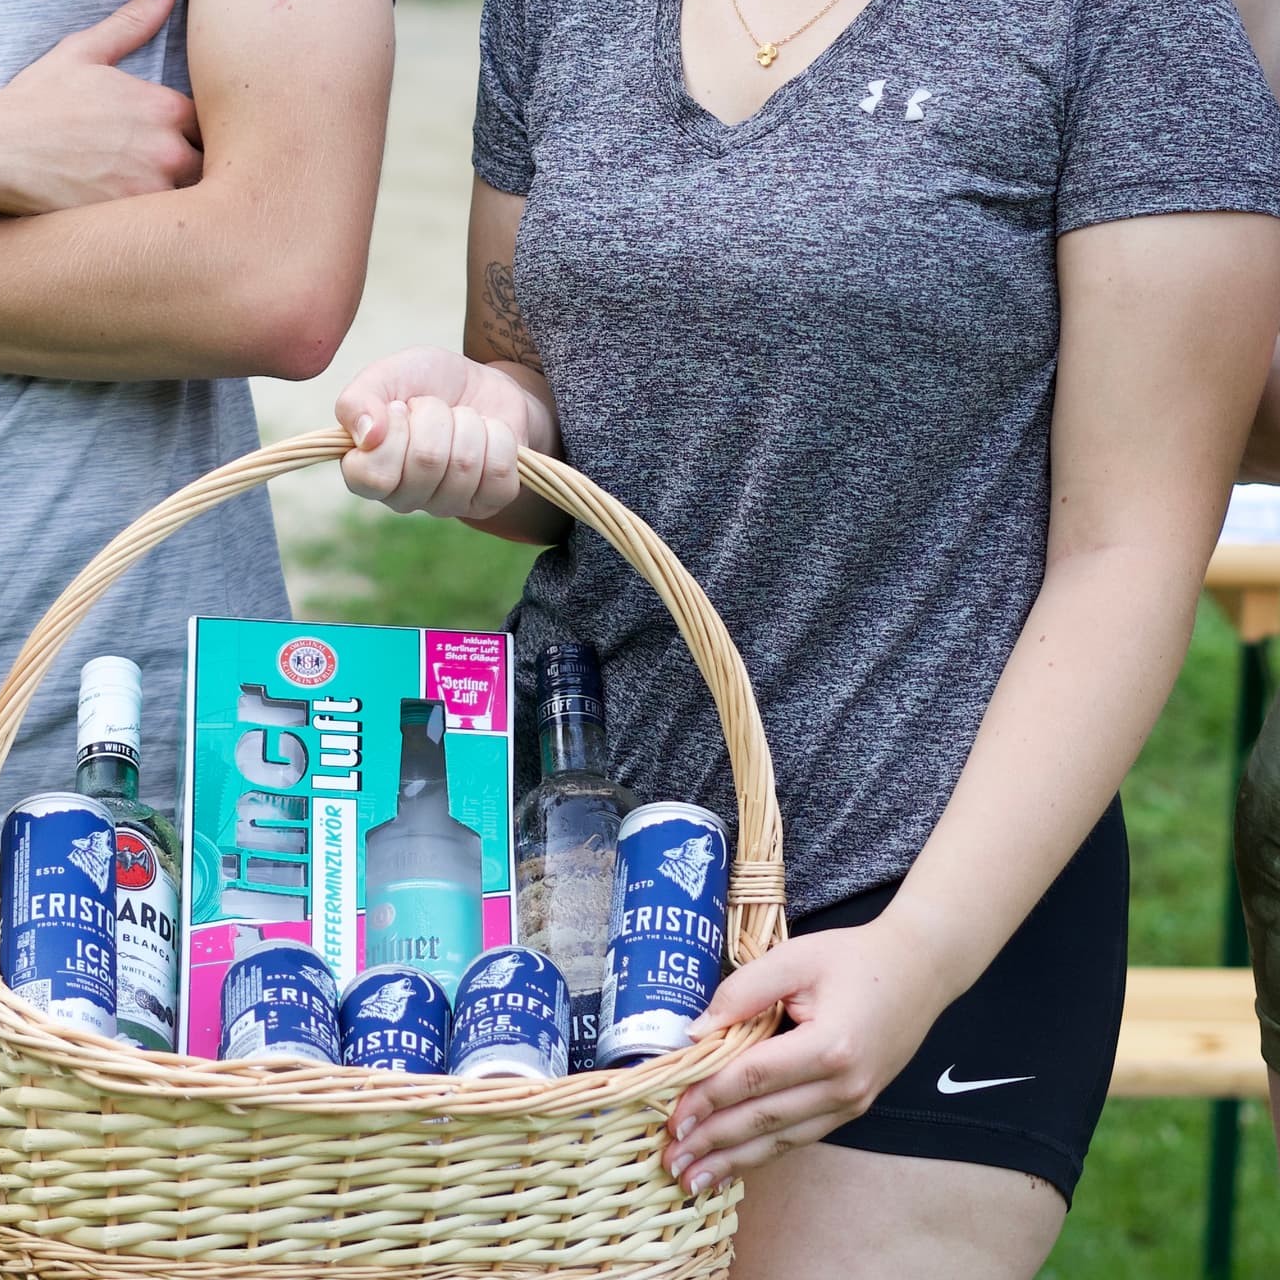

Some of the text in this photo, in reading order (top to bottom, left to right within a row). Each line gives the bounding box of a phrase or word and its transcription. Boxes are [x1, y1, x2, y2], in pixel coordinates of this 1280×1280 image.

[436, 643, 499, 654] 2 Berliner Luft
[445, 651, 468, 661] Shot
[440, 676, 489, 691] Berliner
[451, 690, 478, 706] Luft
[104, 743, 132, 756] WHITE
[311, 695, 363, 792] Luft
[36, 866, 65, 877] ESTD
[628, 879, 655, 892] ESTD
[625, 935, 643, 944] FROM
[663, 934, 683, 942] LAND
[76, 939, 111, 972] ICE
[122, 933, 170, 964] BLANCA
[658, 950, 701, 979] ICE
[66, 957, 114, 990] LEMON
[647, 970, 705, 998] LEMON
[363, 1058, 407, 1072] CE
